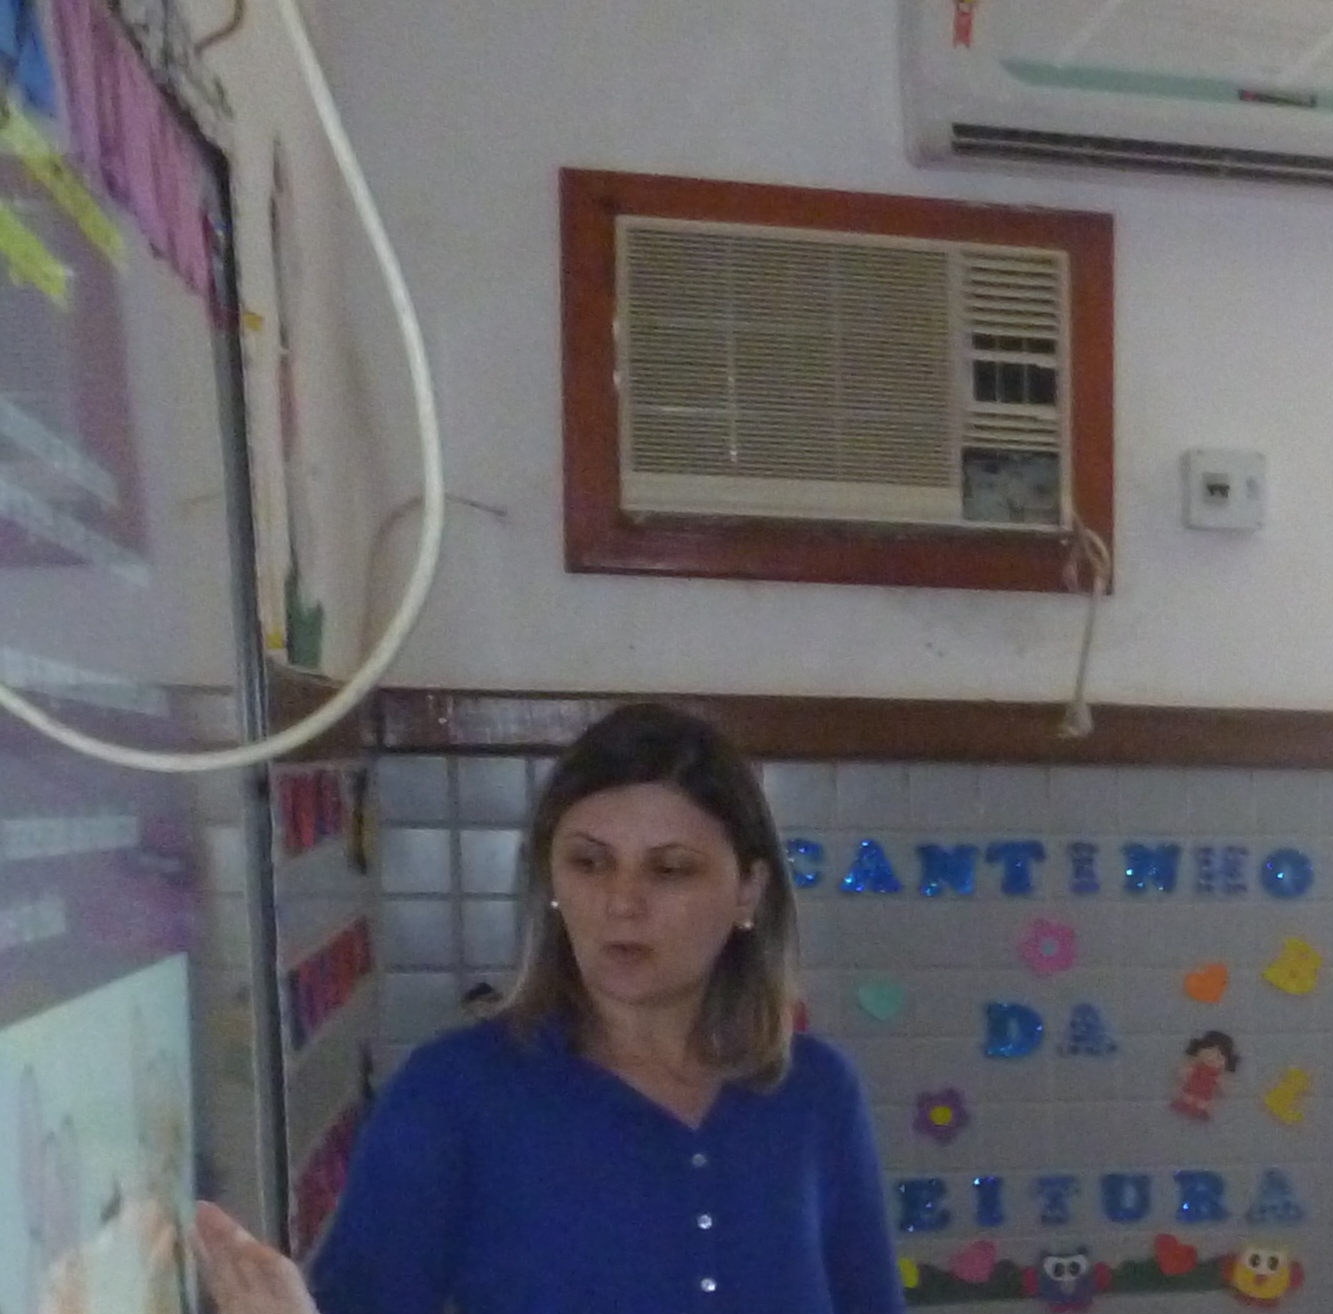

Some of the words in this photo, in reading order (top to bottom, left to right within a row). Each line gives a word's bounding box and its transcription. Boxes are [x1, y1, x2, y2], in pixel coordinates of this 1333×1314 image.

[785, 838, 1315, 897] CANTINHO
[984, 1001, 1117, 1059] DA
[897, 1168, 1305, 1232] EITURA
